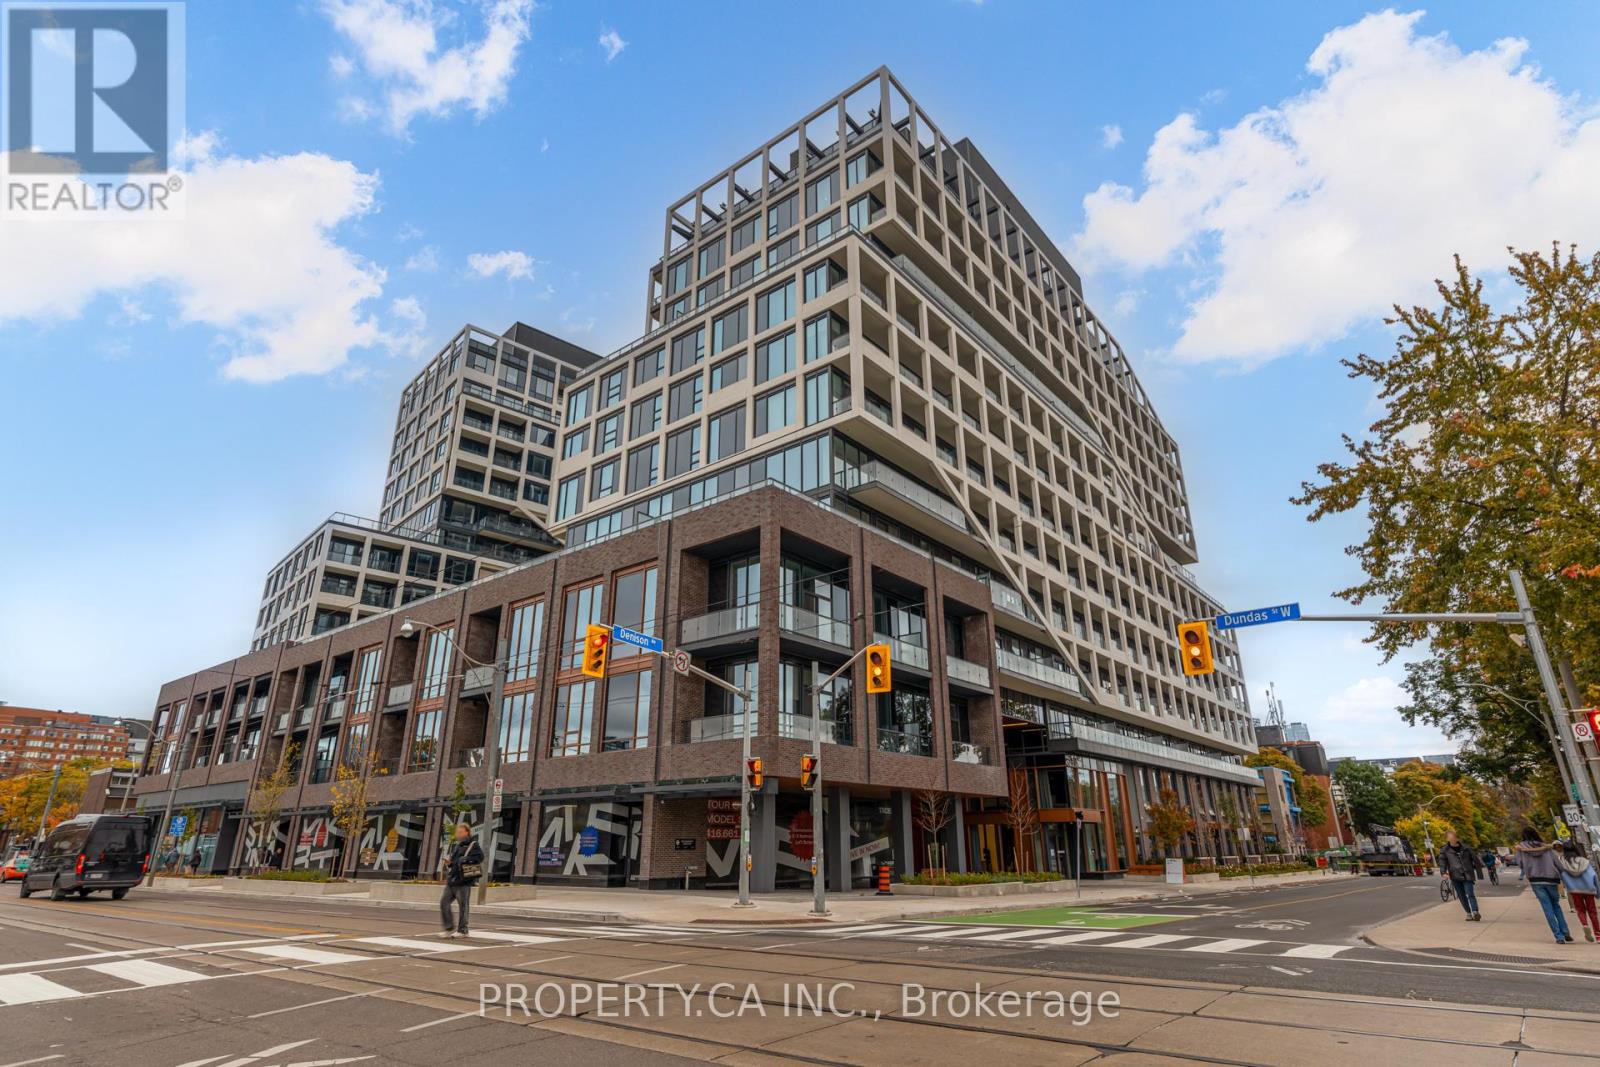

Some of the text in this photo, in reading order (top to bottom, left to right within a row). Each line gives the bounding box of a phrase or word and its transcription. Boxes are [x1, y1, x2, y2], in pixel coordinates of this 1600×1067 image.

[1224, 611, 1268, 626] Dundas
[1280, 606, 1291, 617] W
[620, 628, 649, 647] Denison
[1567, 812, 1580, 823] 30
